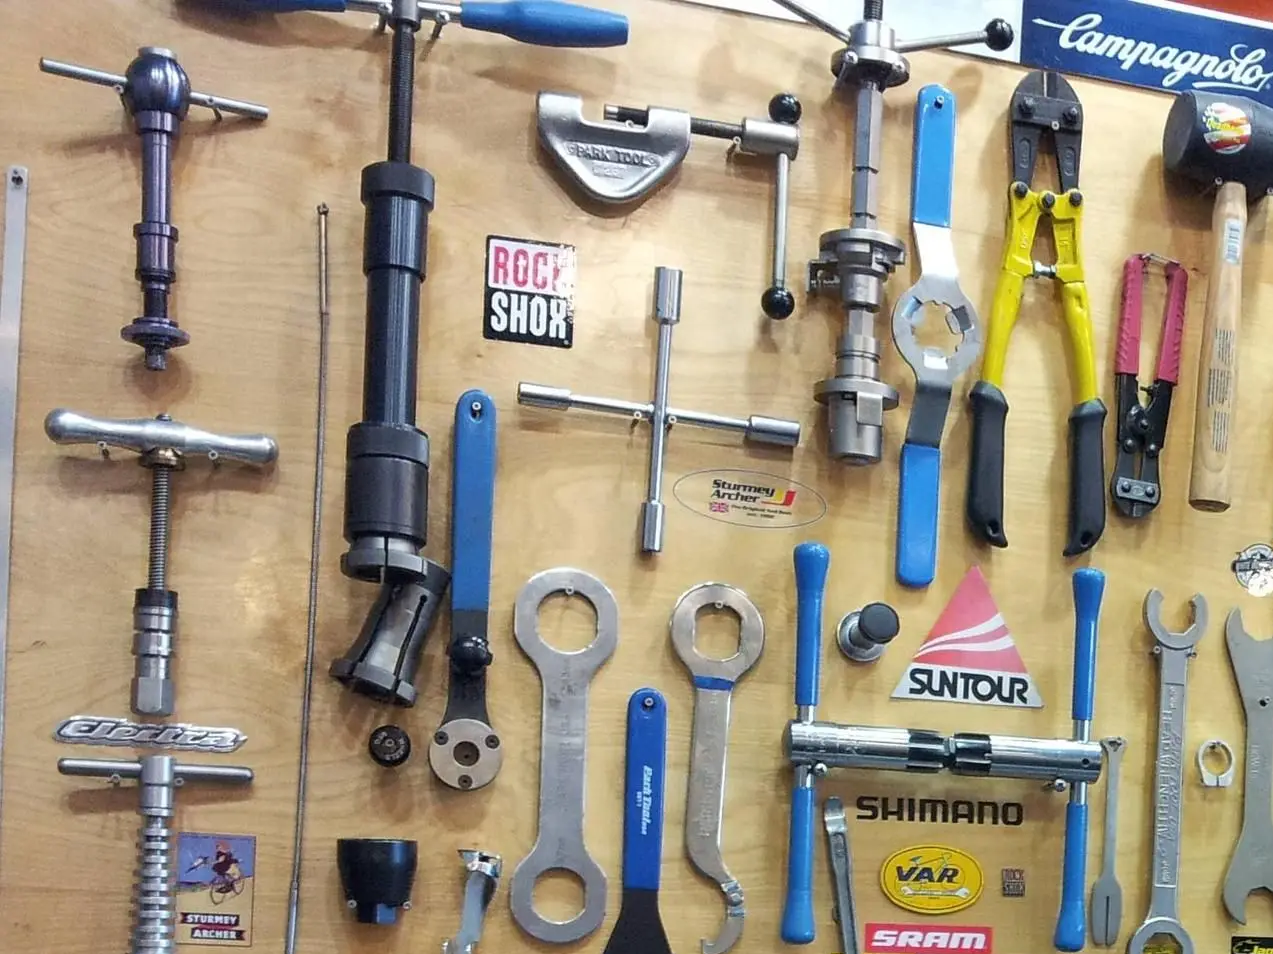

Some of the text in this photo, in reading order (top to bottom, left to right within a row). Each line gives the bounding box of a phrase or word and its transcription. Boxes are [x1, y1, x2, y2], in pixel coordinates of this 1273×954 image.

[490, 291, 567, 338] SHOX
[711, 489, 760, 503] Archer
[712, 479, 775, 497] Sturmey
[909, 668, 1028, 704] SUNTOUR
[58, 719, 239, 748] Electra
[643, 765, 652, 795] Park
[642, 796, 651, 823] Tool
[856, 796, 1024, 825] SHIMANO
[895, 865, 960, 883] VAR
[187, 914, 237, 925] STURMEY
[193, 930, 237, 940] ARCHER
[871, 930, 986, 949] SRAM
